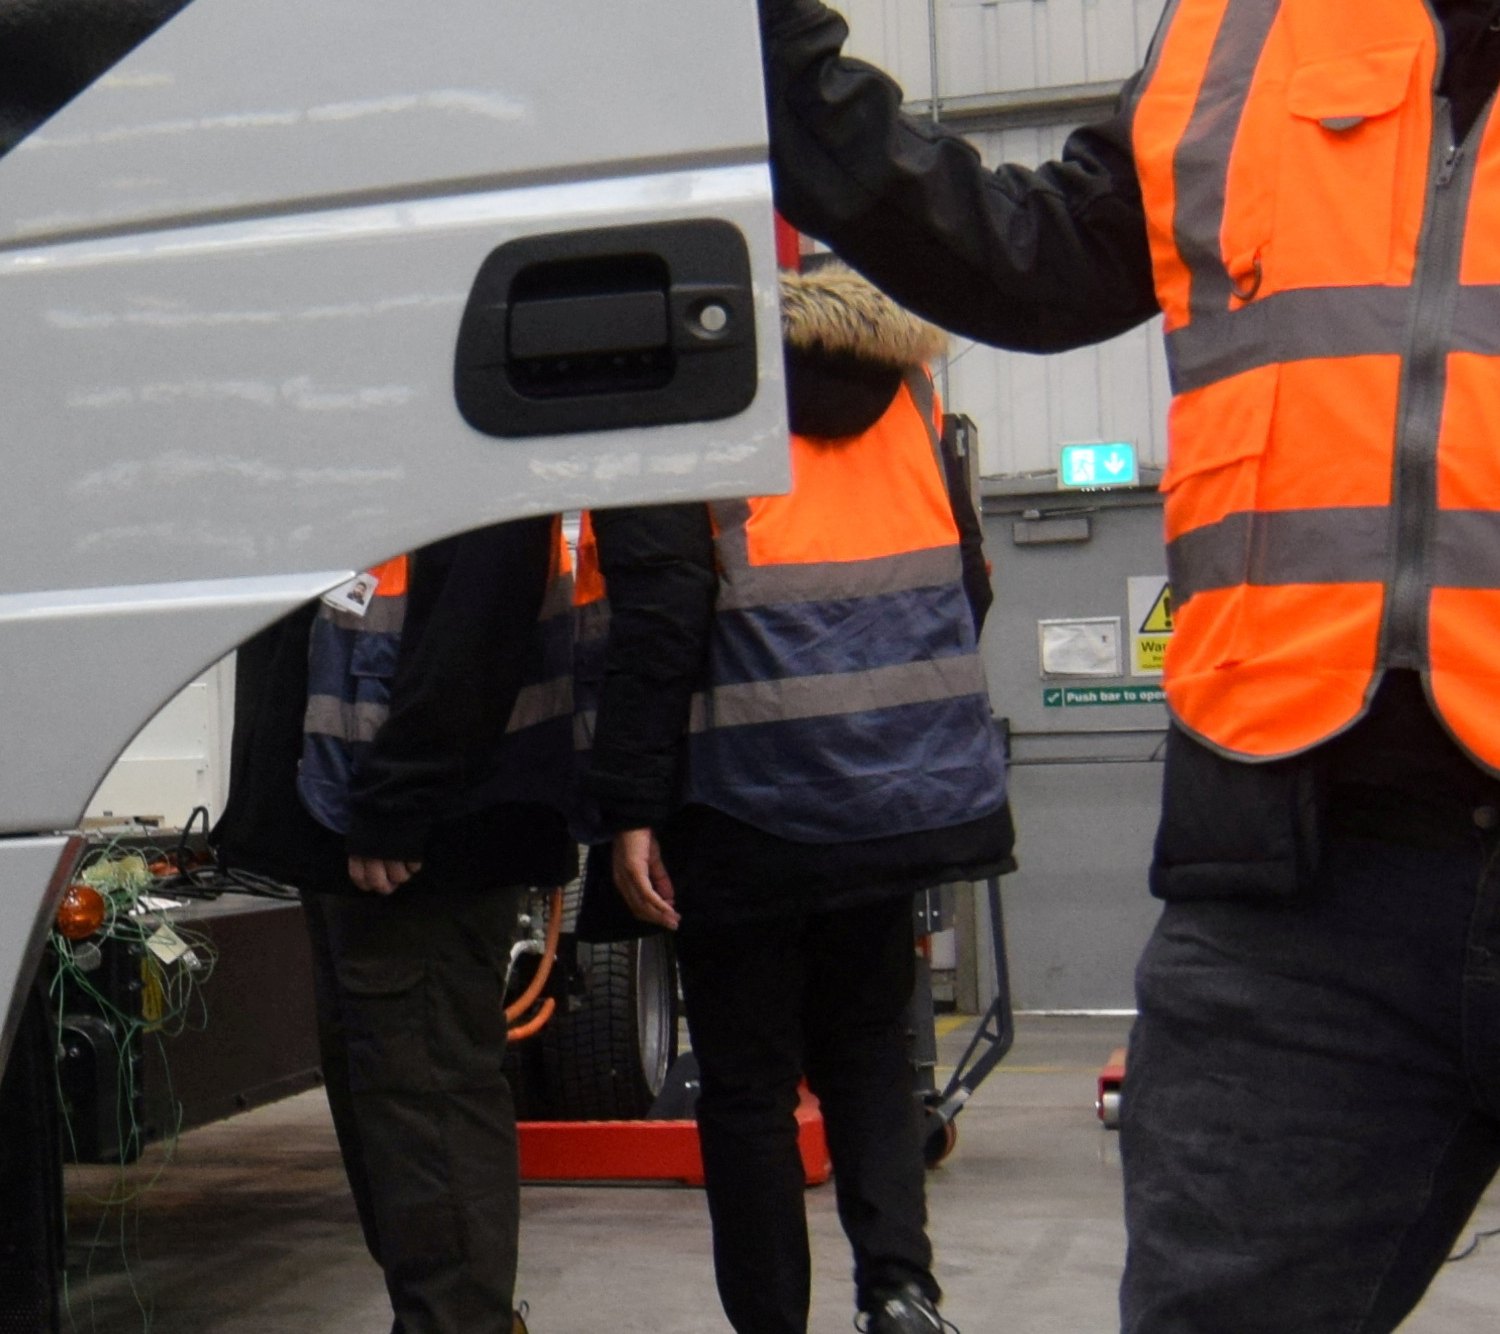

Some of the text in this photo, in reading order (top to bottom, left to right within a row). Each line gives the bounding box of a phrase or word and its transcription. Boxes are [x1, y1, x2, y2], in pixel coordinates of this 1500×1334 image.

[1066, 690, 1097, 703] Push
[1100, 690, 1121, 702] bar
[1123, 690, 1136, 701] to
